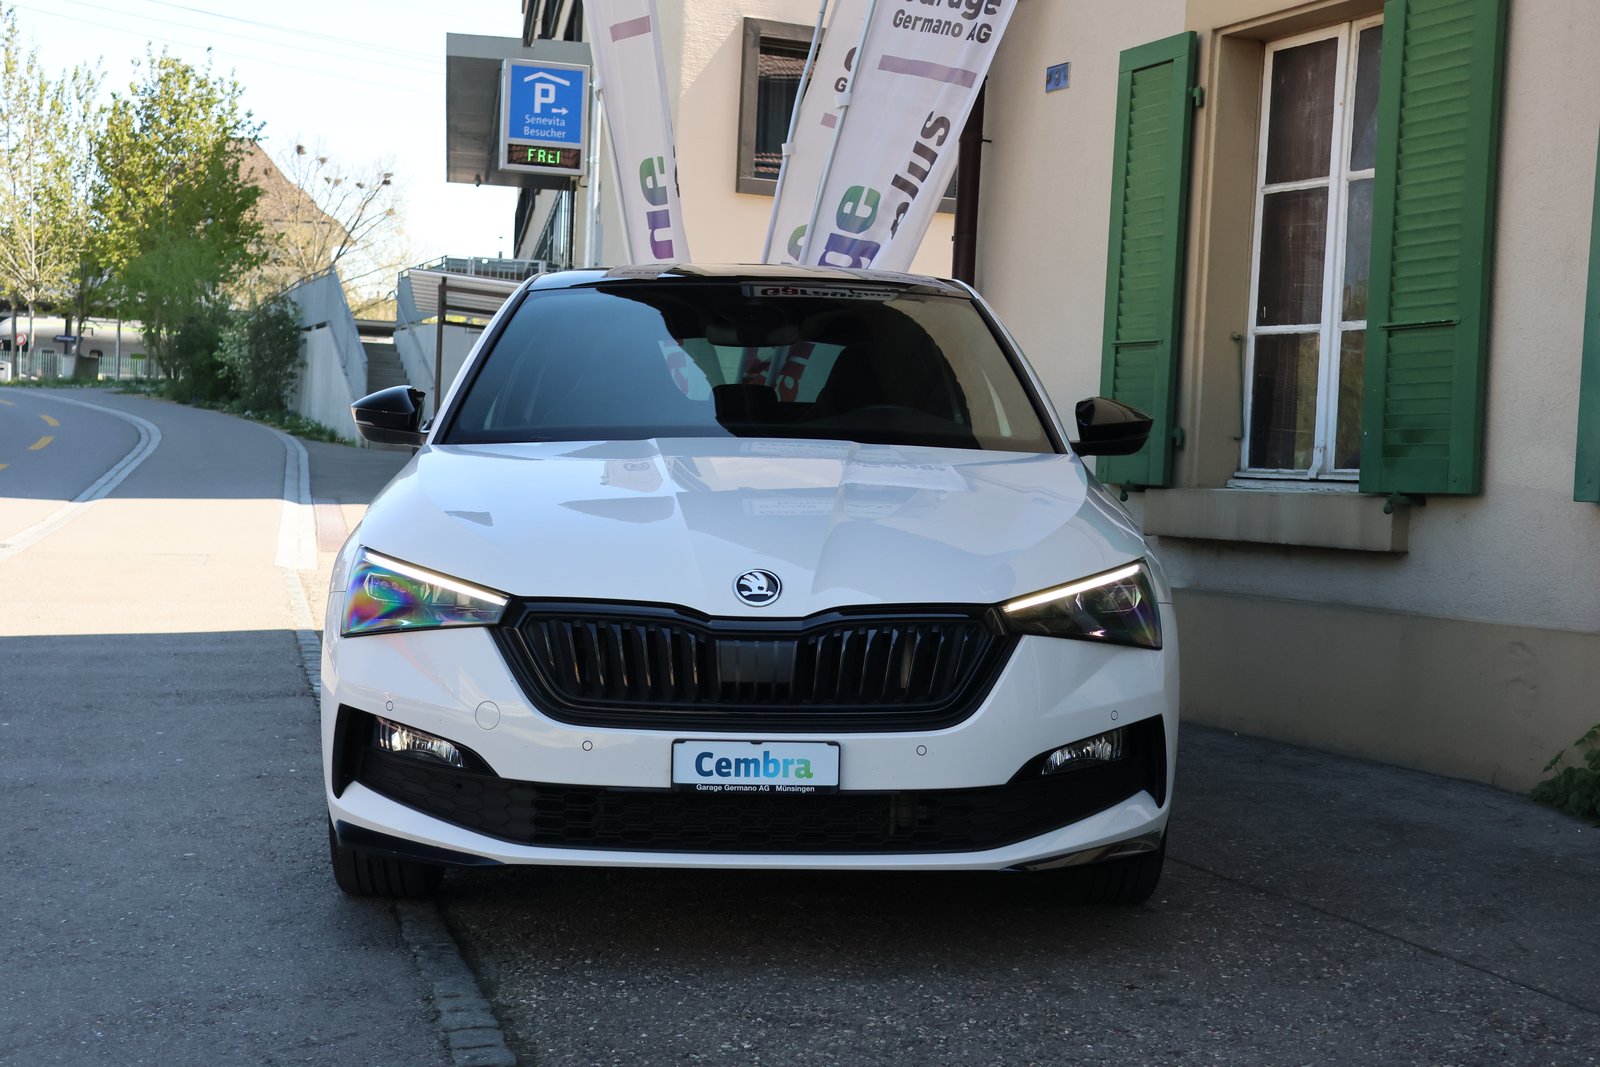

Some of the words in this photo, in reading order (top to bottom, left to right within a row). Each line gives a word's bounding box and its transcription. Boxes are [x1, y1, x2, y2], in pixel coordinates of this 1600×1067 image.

[892, 9, 964, 38] Germano
[965, 22, 993, 43] AG
[534, 82, 556, 114] P
[524, 114, 566, 127] Senevita
[523, 126, 567, 138] Besucher
[527, 148, 561, 164] FREI
[695, 750, 814, 779] Cembra
[696, 784, 723, 793] Garage
[724, 784, 757, 792] Germano
[775, 785, 815, 793] Münsingen
